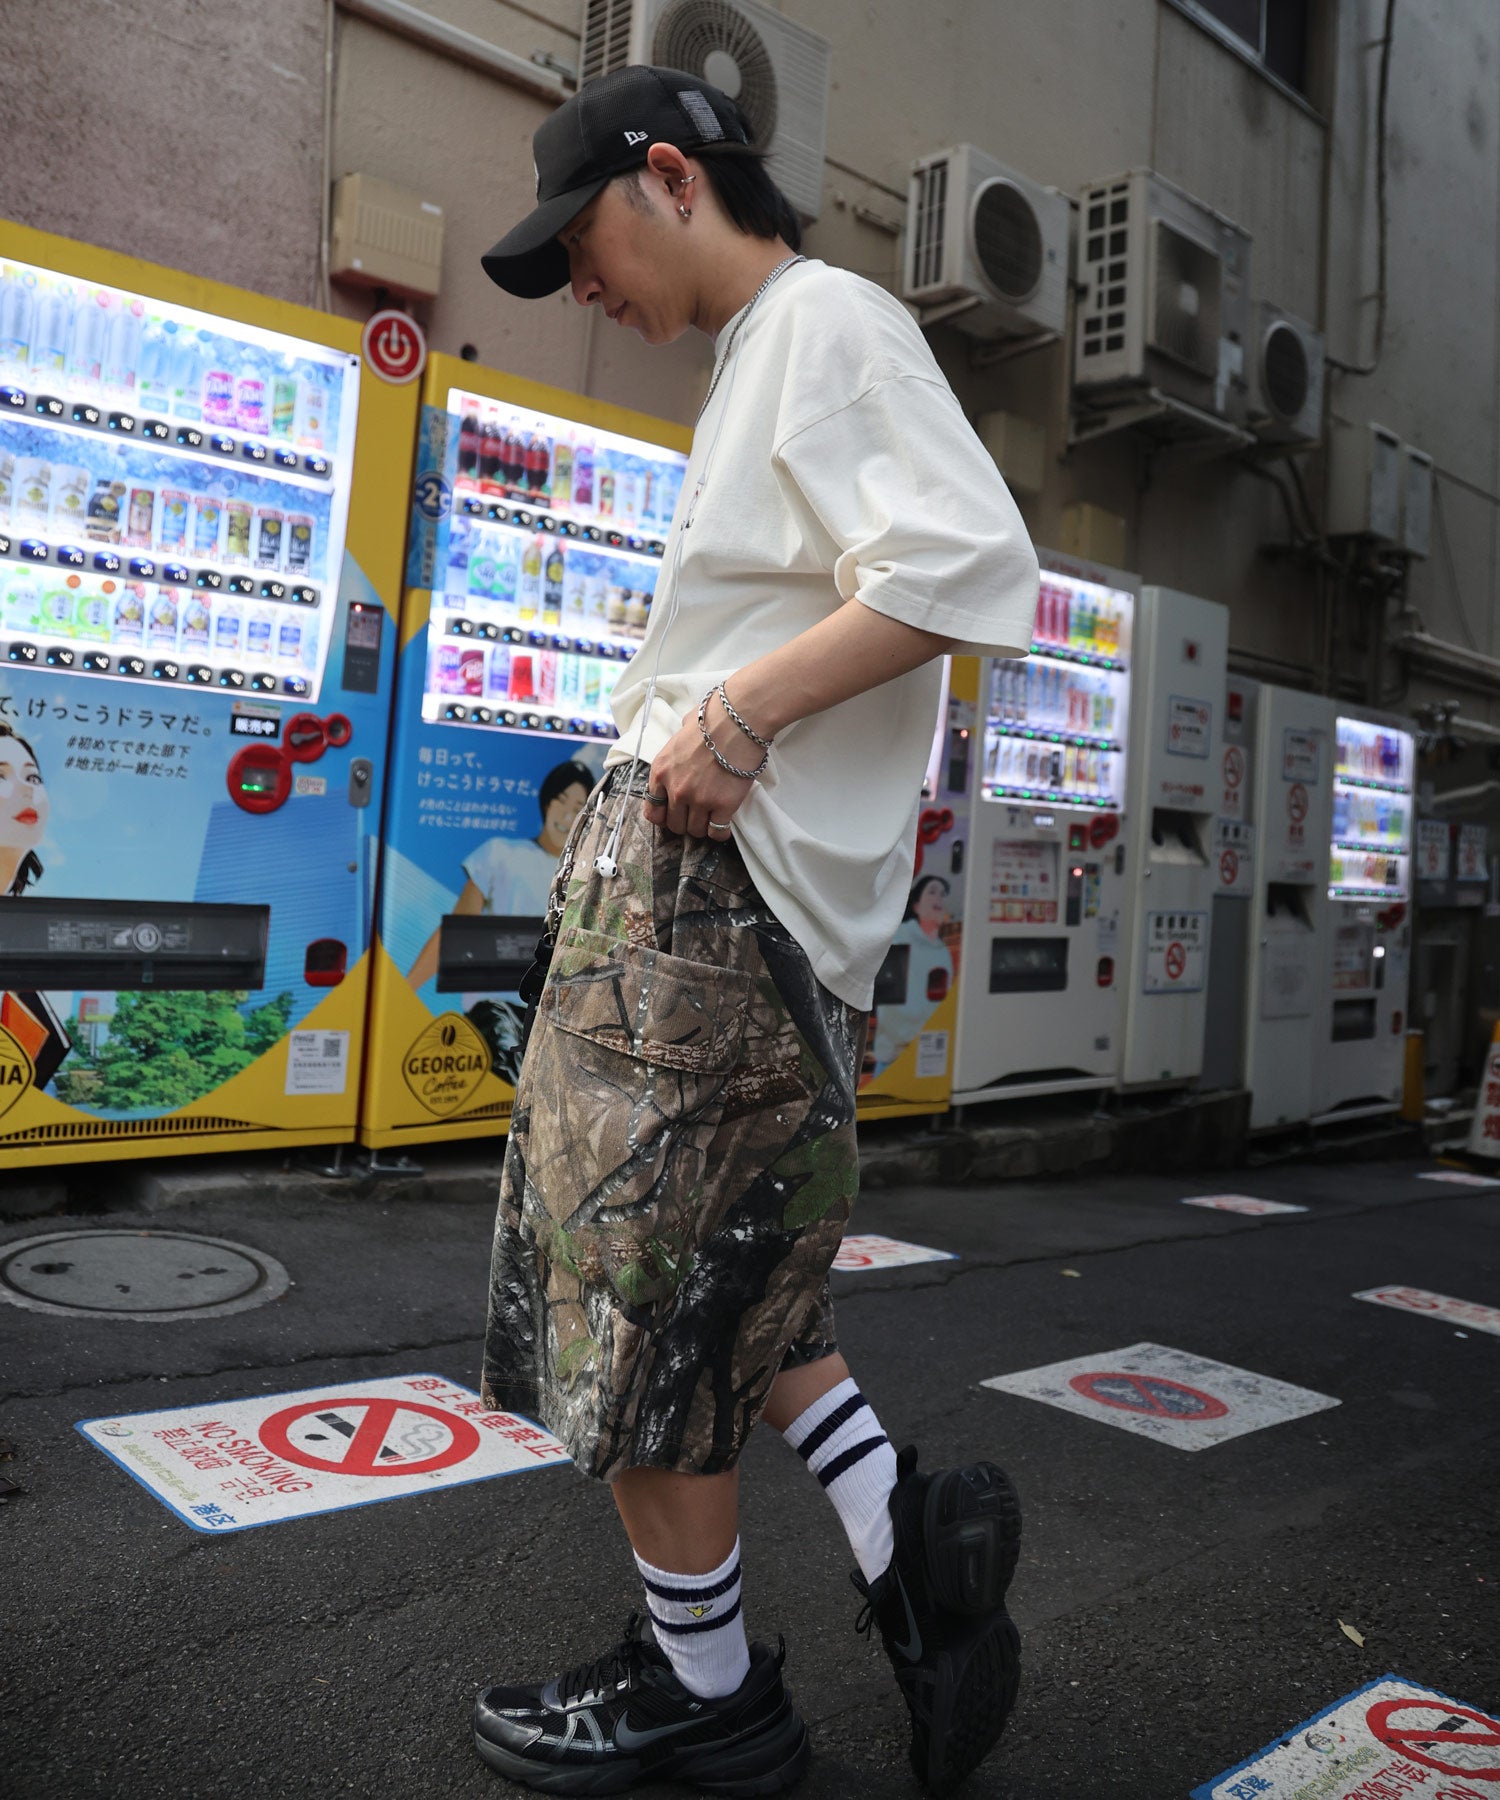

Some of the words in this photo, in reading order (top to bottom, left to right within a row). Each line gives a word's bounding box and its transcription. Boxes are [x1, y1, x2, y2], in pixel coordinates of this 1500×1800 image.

[418, 747, 484, 769] 毎日って、
[418, 771, 539, 798] けっこうドラマだ。
[407, 1055, 483, 1075] GEORGIA
[191, 1420, 237, 1439] NO
[216, 1438, 313, 1494] SMOKING
[189, 1502, 238, 1527] 港区
